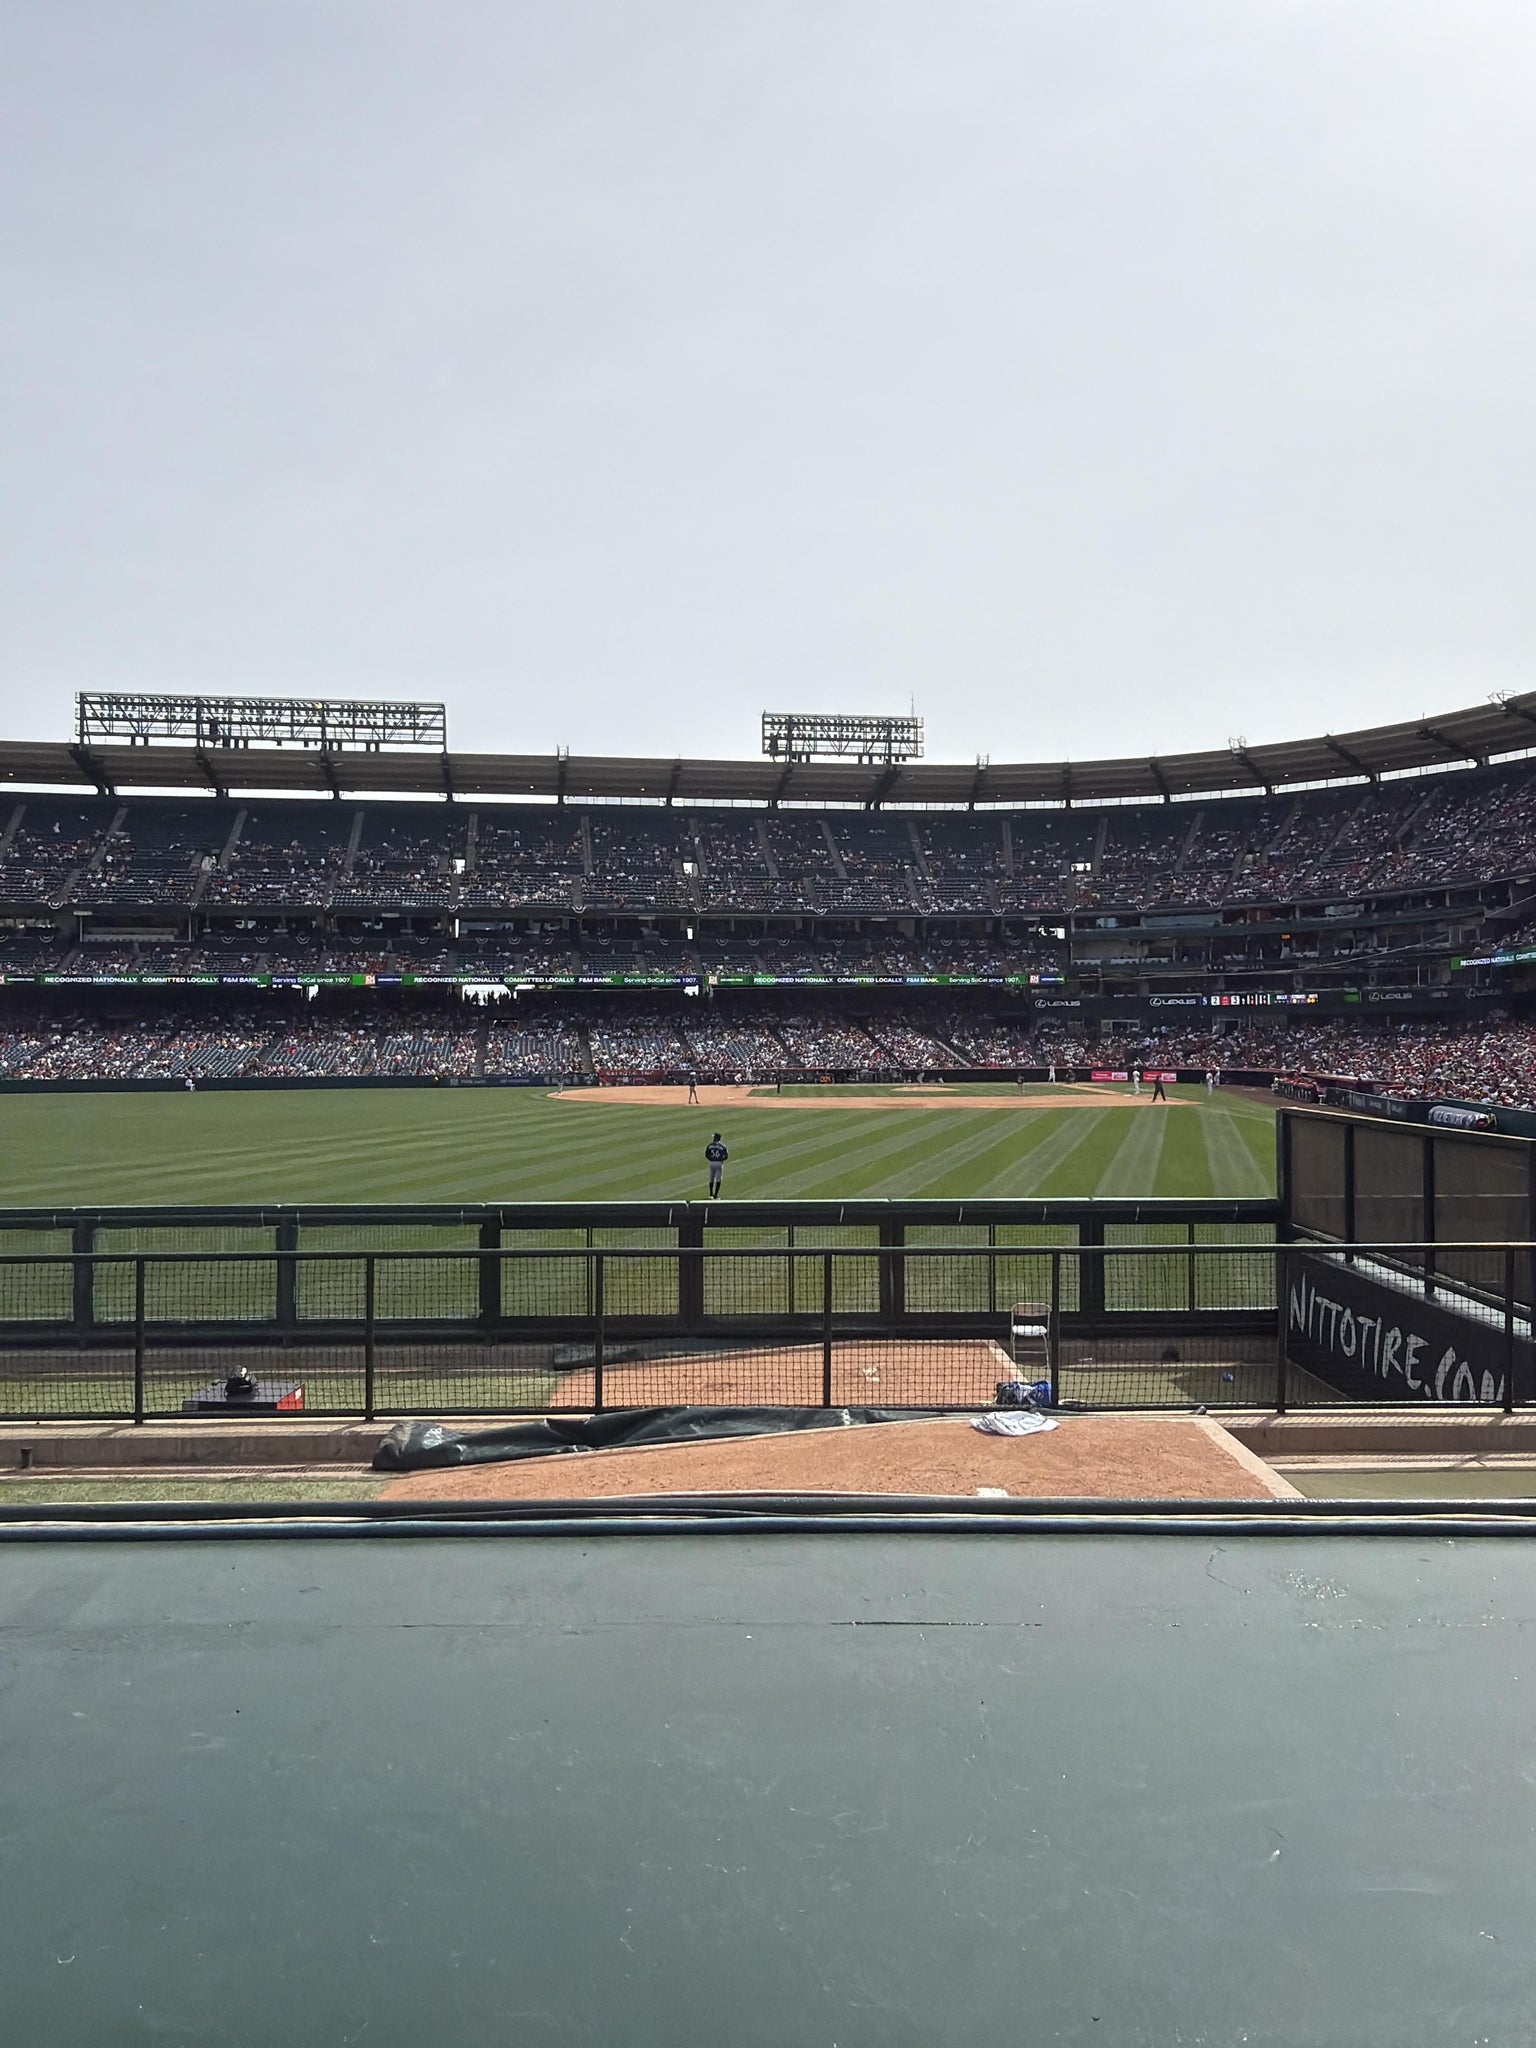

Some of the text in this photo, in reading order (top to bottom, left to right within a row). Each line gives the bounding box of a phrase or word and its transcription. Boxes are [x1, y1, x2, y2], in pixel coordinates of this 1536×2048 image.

[45, 976, 92, 984] RECOGNIZED
[142, 976, 185, 984] COMMITTED
[414, 976, 457, 984] RECOGNIZED
[504, 976, 544, 984] COMMITTED
[754, 976, 794, 984] RECOGNIZED
[837, 976, 874, 984] COMMITTED
[1380, 992, 1413, 1000] LEXUS
[711, 1149, 720, 1158] 56
